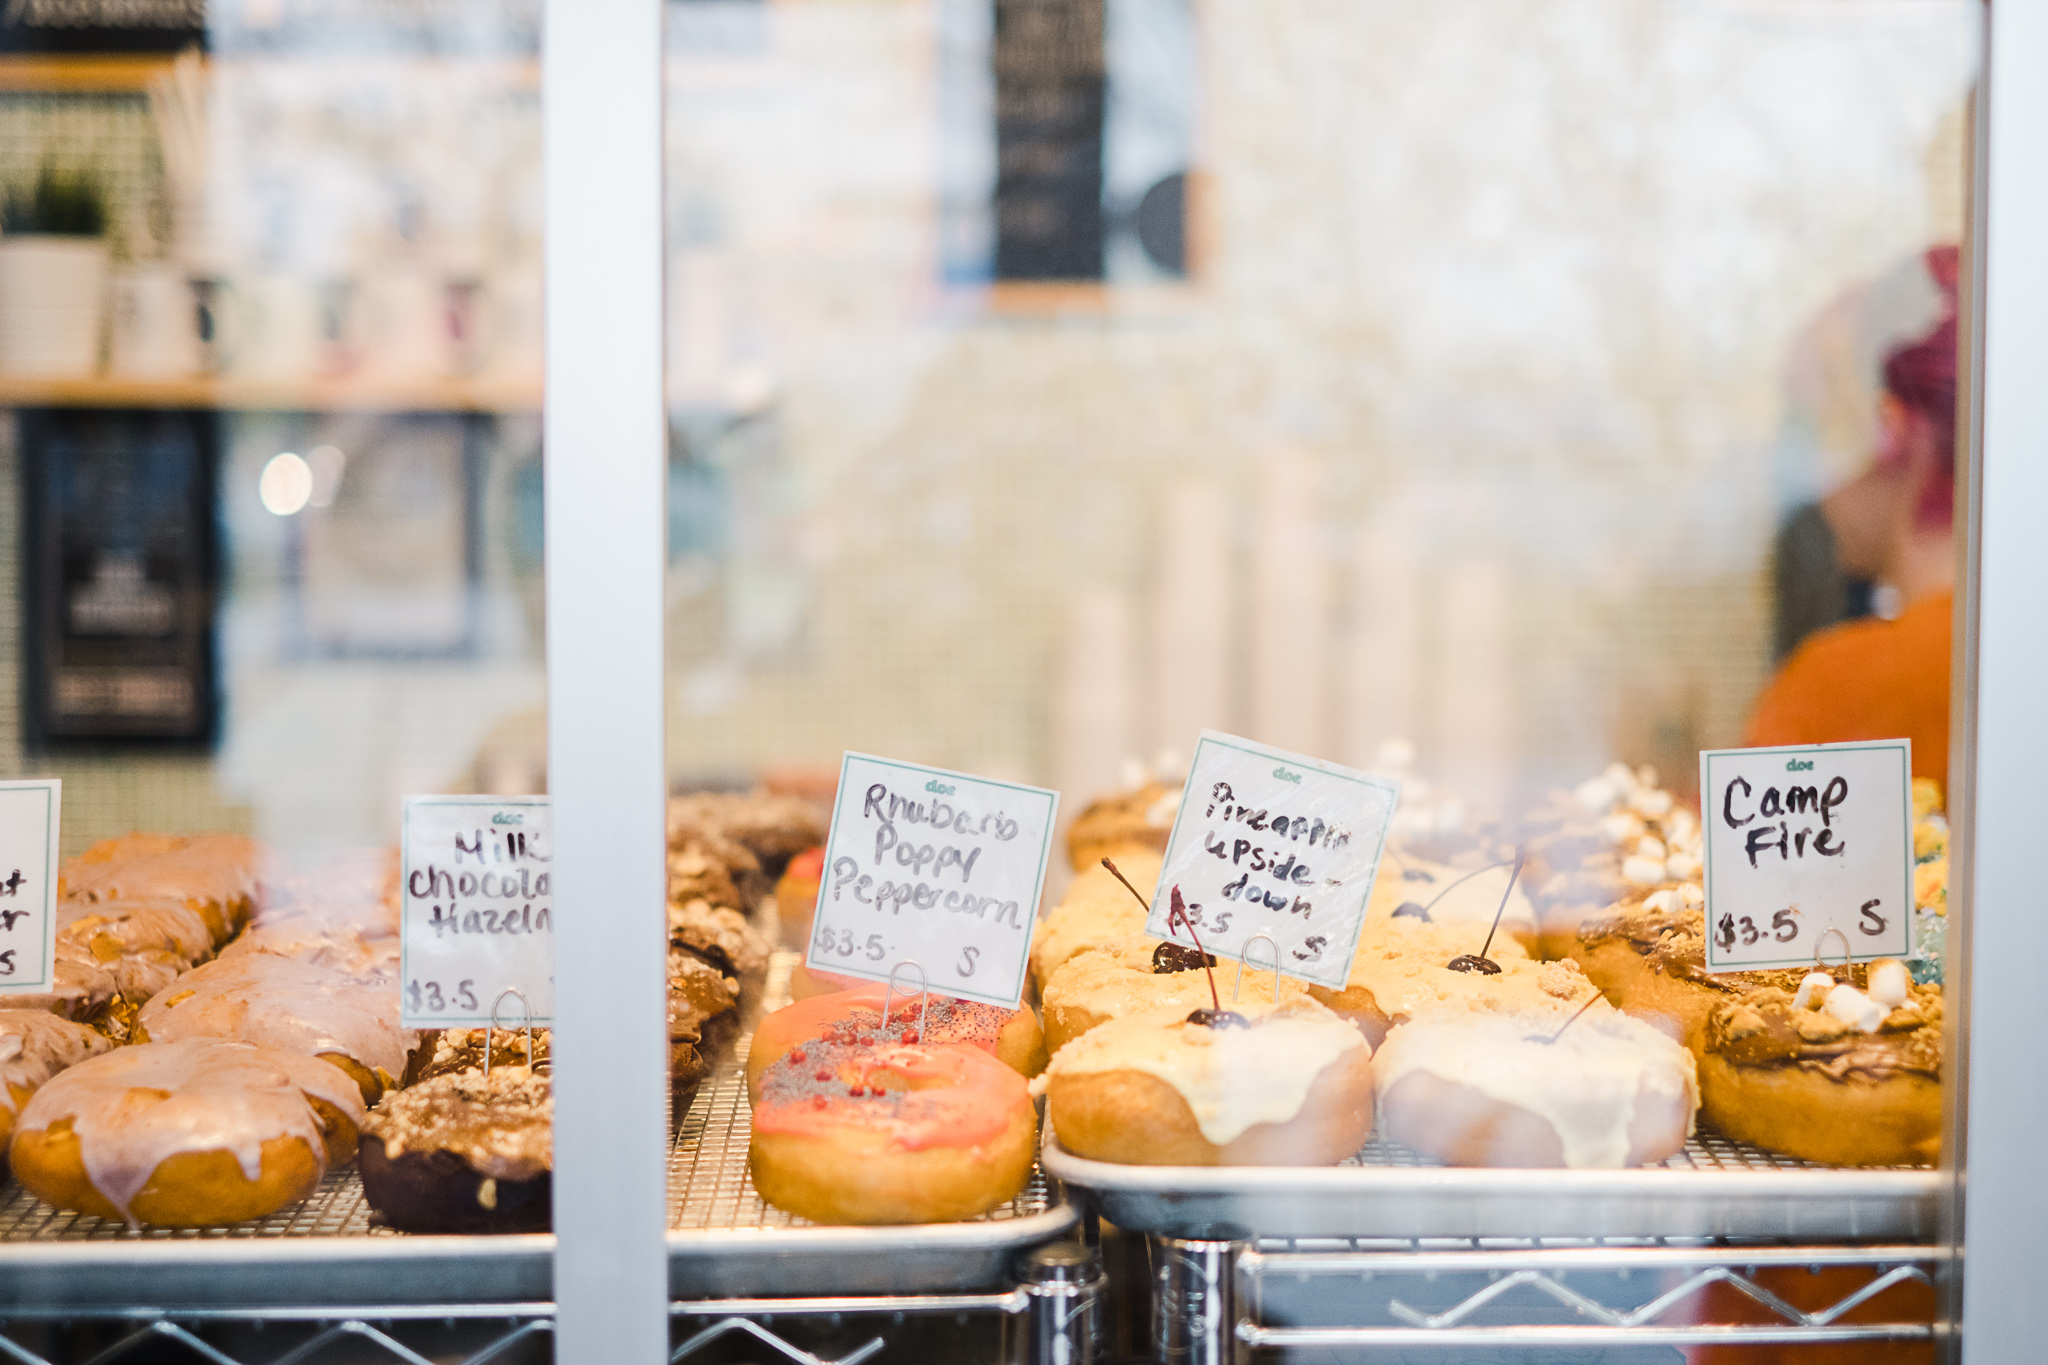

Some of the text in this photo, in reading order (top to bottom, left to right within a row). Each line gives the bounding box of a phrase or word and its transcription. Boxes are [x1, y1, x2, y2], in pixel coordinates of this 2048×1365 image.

[1272, 766, 1302, 785] doe
[1786, 758, 1814, 771] doe
[925, 779, 956, 796] doe
[455, 829, 552, 865] Milk
[874, 822, 982, 883] Poppy
[1745, 821, 1845, 869] Fire
[832, 856, 1022, 930] Peppercorn
[1221, 873, 1312, 920] down
[1714, 898, 1886, 953] $3.5 S
[957, 946, 980, 978] S
[1293, 935, 1328, 962] S
[406, 979, 478, 1013] $3.5
